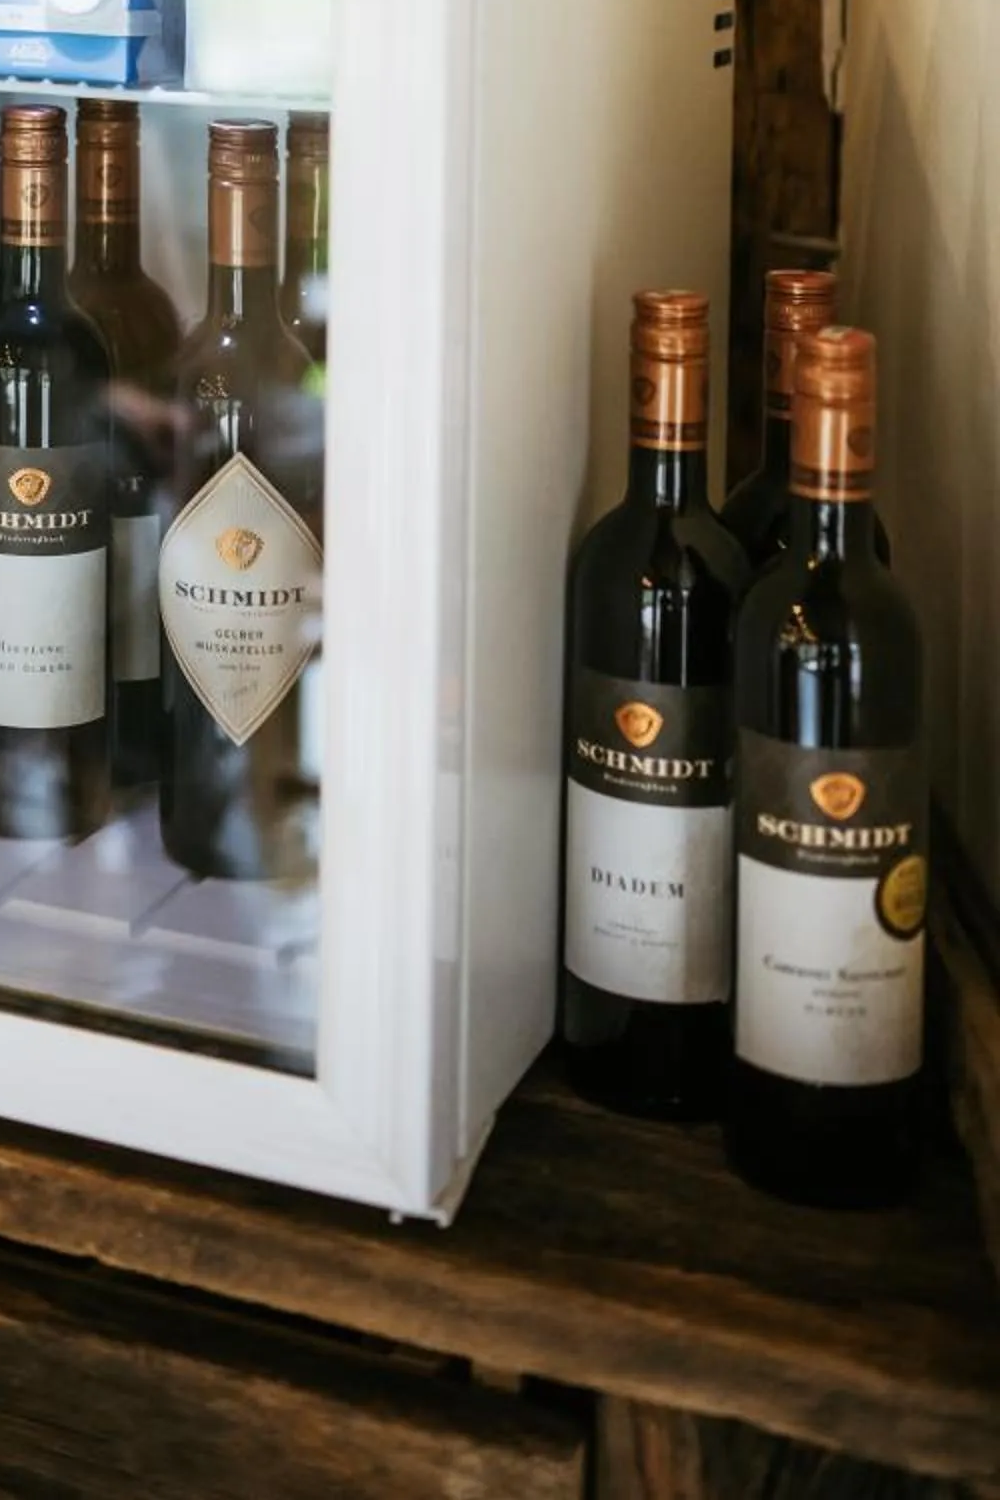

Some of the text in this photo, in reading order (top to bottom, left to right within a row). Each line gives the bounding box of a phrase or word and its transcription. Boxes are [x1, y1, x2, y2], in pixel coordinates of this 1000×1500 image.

[174, 579, 307, 608] SCHMIDT
[575, 737, 716, 780] SCHMIDT
[756, 812, 913, 850] SCHMIDT
[588, 865, 687, 900] DIADEM
